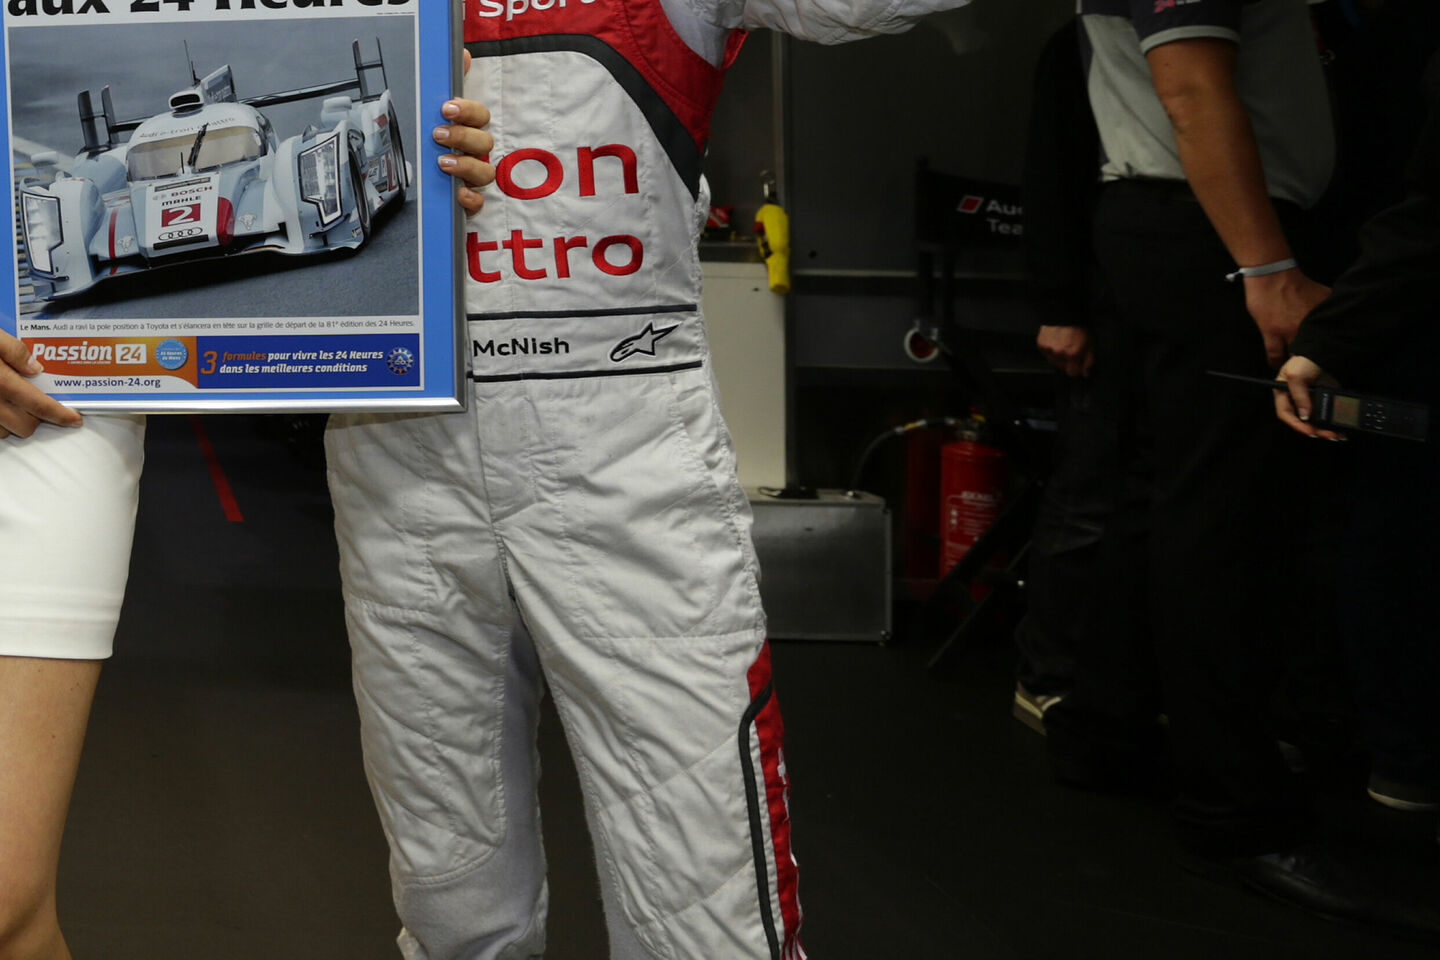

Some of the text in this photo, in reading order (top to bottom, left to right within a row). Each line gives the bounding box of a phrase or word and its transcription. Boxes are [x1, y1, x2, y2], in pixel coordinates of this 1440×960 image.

[170, 186, 213, 198] BOSCH
[167, 205, 195, 226] 2
[985, 217, 1023, 236] Tea
[466, 229, 644, 284] ttro
[96, 323, 112, 331] pole
[112, 323, 139, 331] position
[146, 322, 170, 331] Toyota
[285, 321, 307, 330] départ
[32, 340, 142, 362] Passion 24
[473, 337, 570, 357] McNish
[201, 350, 384, 375] 3 formules pour vivre les 24 Heures
[219, 363, 368, 374] dans les meilleures conditions
[54, 377, 161, 388] www.passion-24.org
